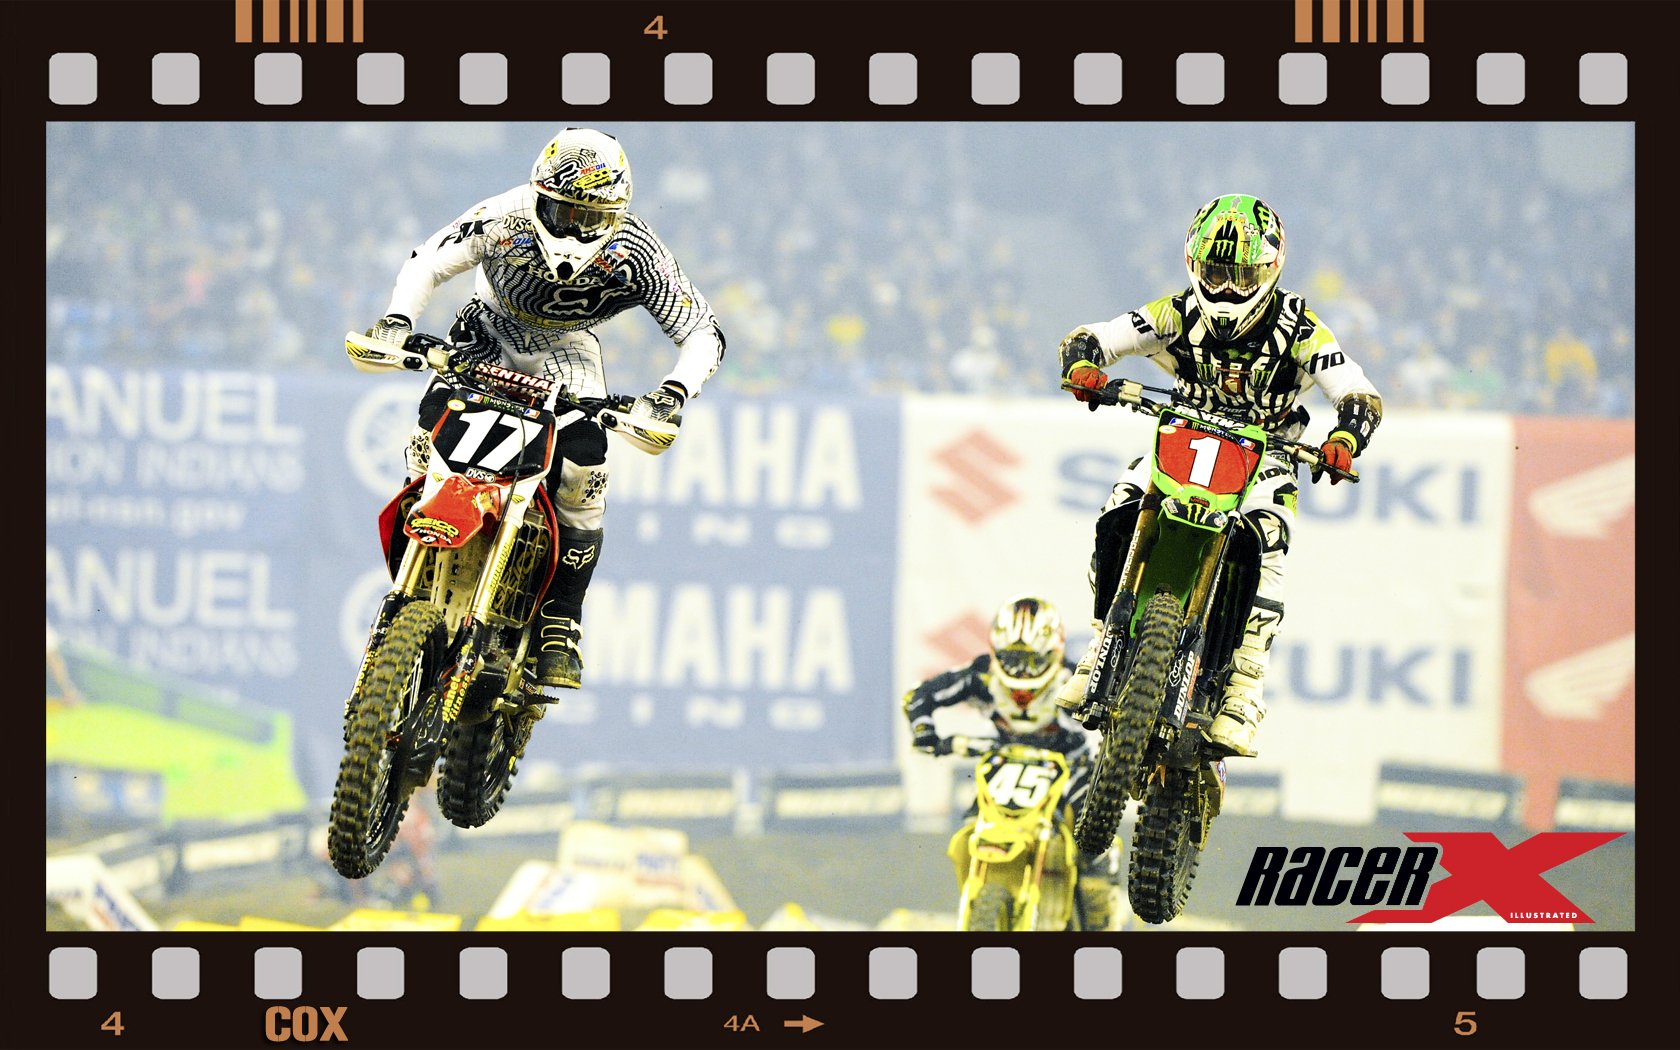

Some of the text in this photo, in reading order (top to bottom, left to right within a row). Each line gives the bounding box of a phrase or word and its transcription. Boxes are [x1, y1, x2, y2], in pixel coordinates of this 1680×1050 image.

[453, 408, 544, 473] 17
[1188, 436, 1222, 488] 1
[465, 468, 485, 480] DVS
[442, 675, 461, 723] planet
[450, 674, 471, 722] fitness
[1173, 650, 1195, 720] DUNLOP
[988, 762, 1057, 808] 45
